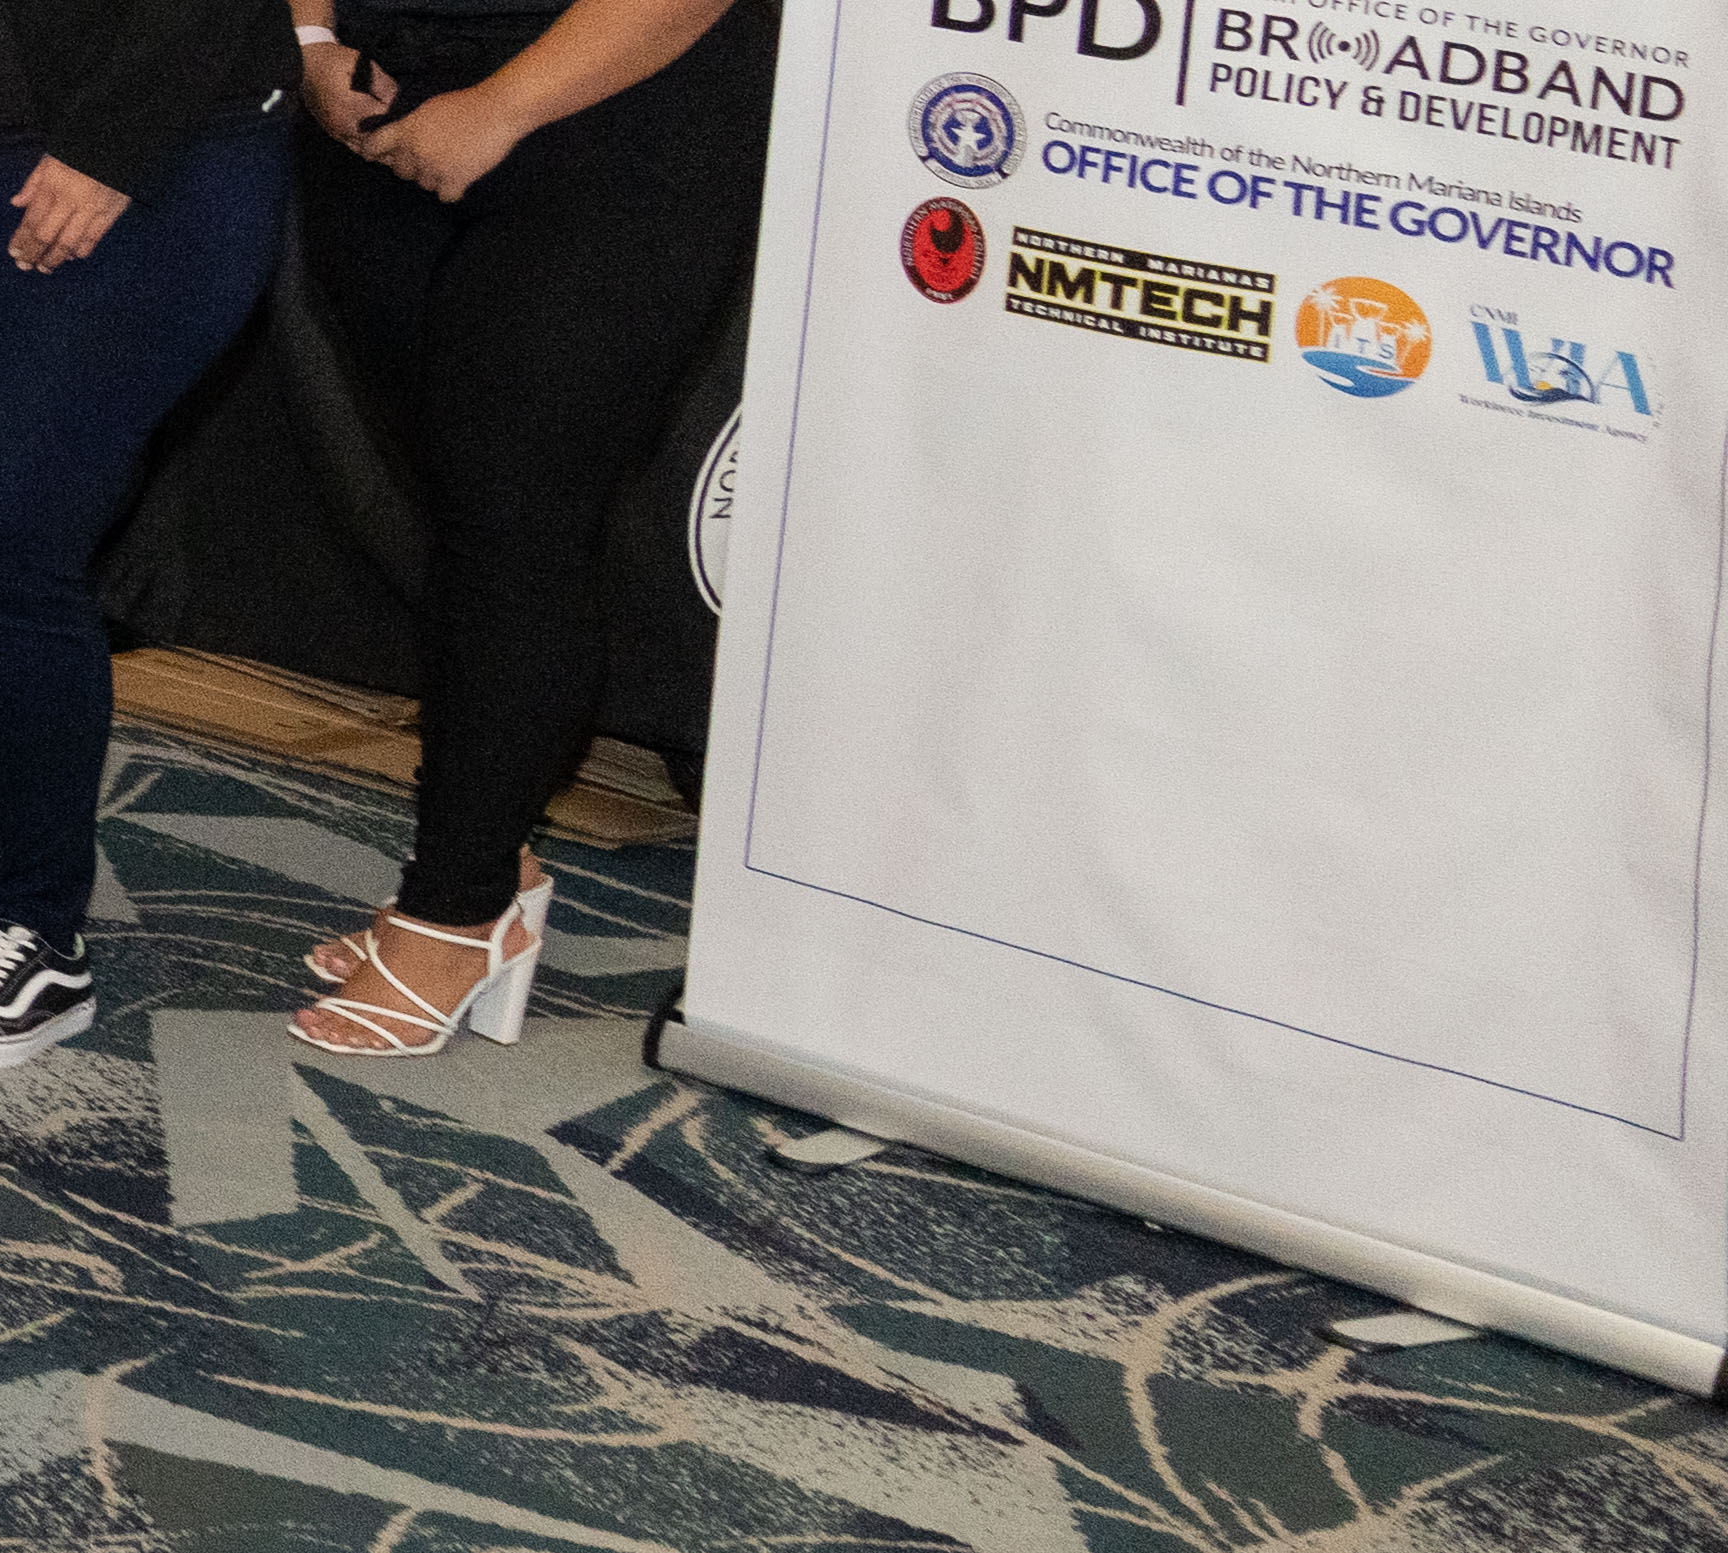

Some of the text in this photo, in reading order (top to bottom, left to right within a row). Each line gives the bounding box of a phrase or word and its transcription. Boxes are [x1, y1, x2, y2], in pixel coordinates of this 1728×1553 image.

[1419, 7, 1455, 28] OF
[1465, 15, 1518, 39] THE
[1529, 25, 1690, 69] GOVERNOR
[1210, 62, 1681, 170] POLICY & DEVELOPMENT
[1045, 112, 1582, 224] Commonwealth of the Northern Mariana Islands
[1042, 140, 1676, 289] OFFICE OF THE GOVERNOR
[1007, 251, 1271, 337] NMTECH
[1016, 231, 1270, 290] NORTHERN MARIANAS
[1010, 297, 1265, 359] TECHNICAL INSTITUTE
